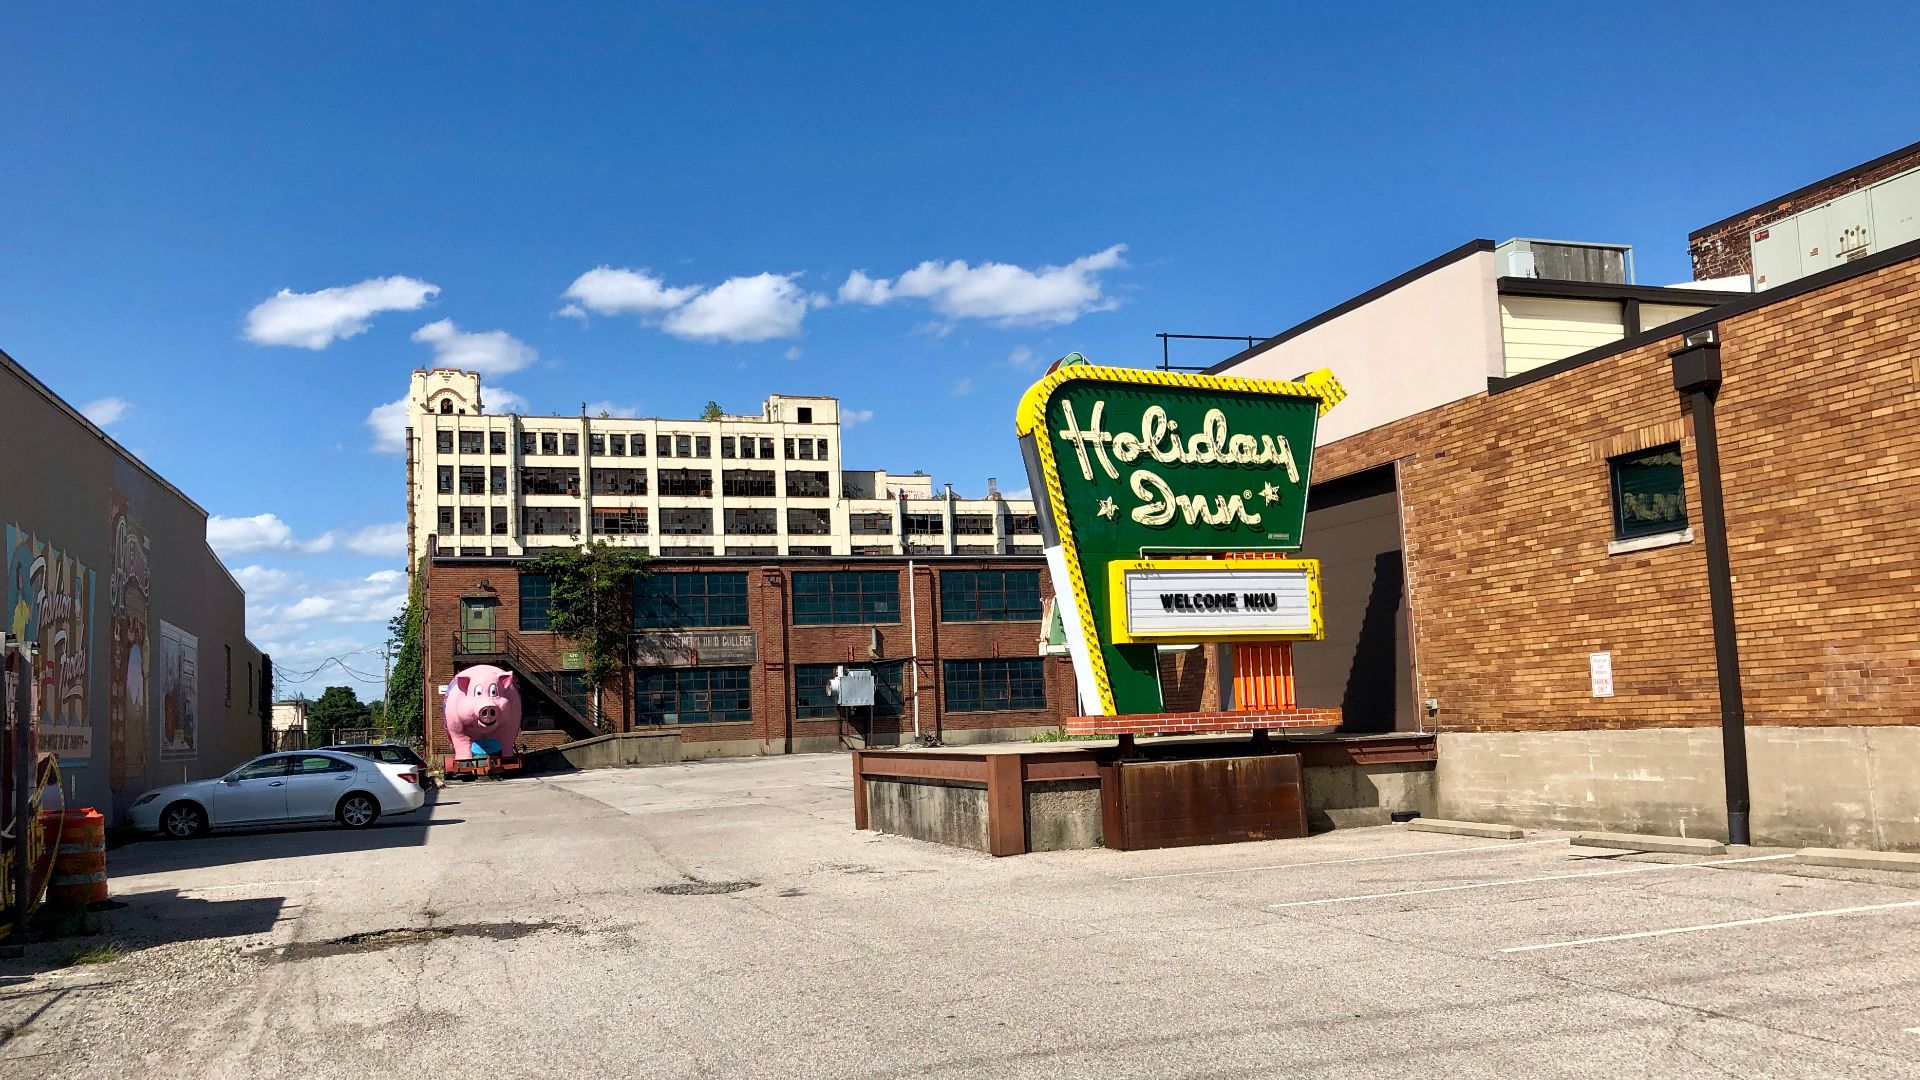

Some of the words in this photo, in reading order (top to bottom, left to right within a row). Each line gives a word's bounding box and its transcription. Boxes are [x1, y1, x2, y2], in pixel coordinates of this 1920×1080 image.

[1059, 399, 1300, 484] Holiday
[1130, 469, 1262, 526] Inn
[1159, 592, 1237, 609] WELCOME
[722, 635, 753, 647] COLLEGE
